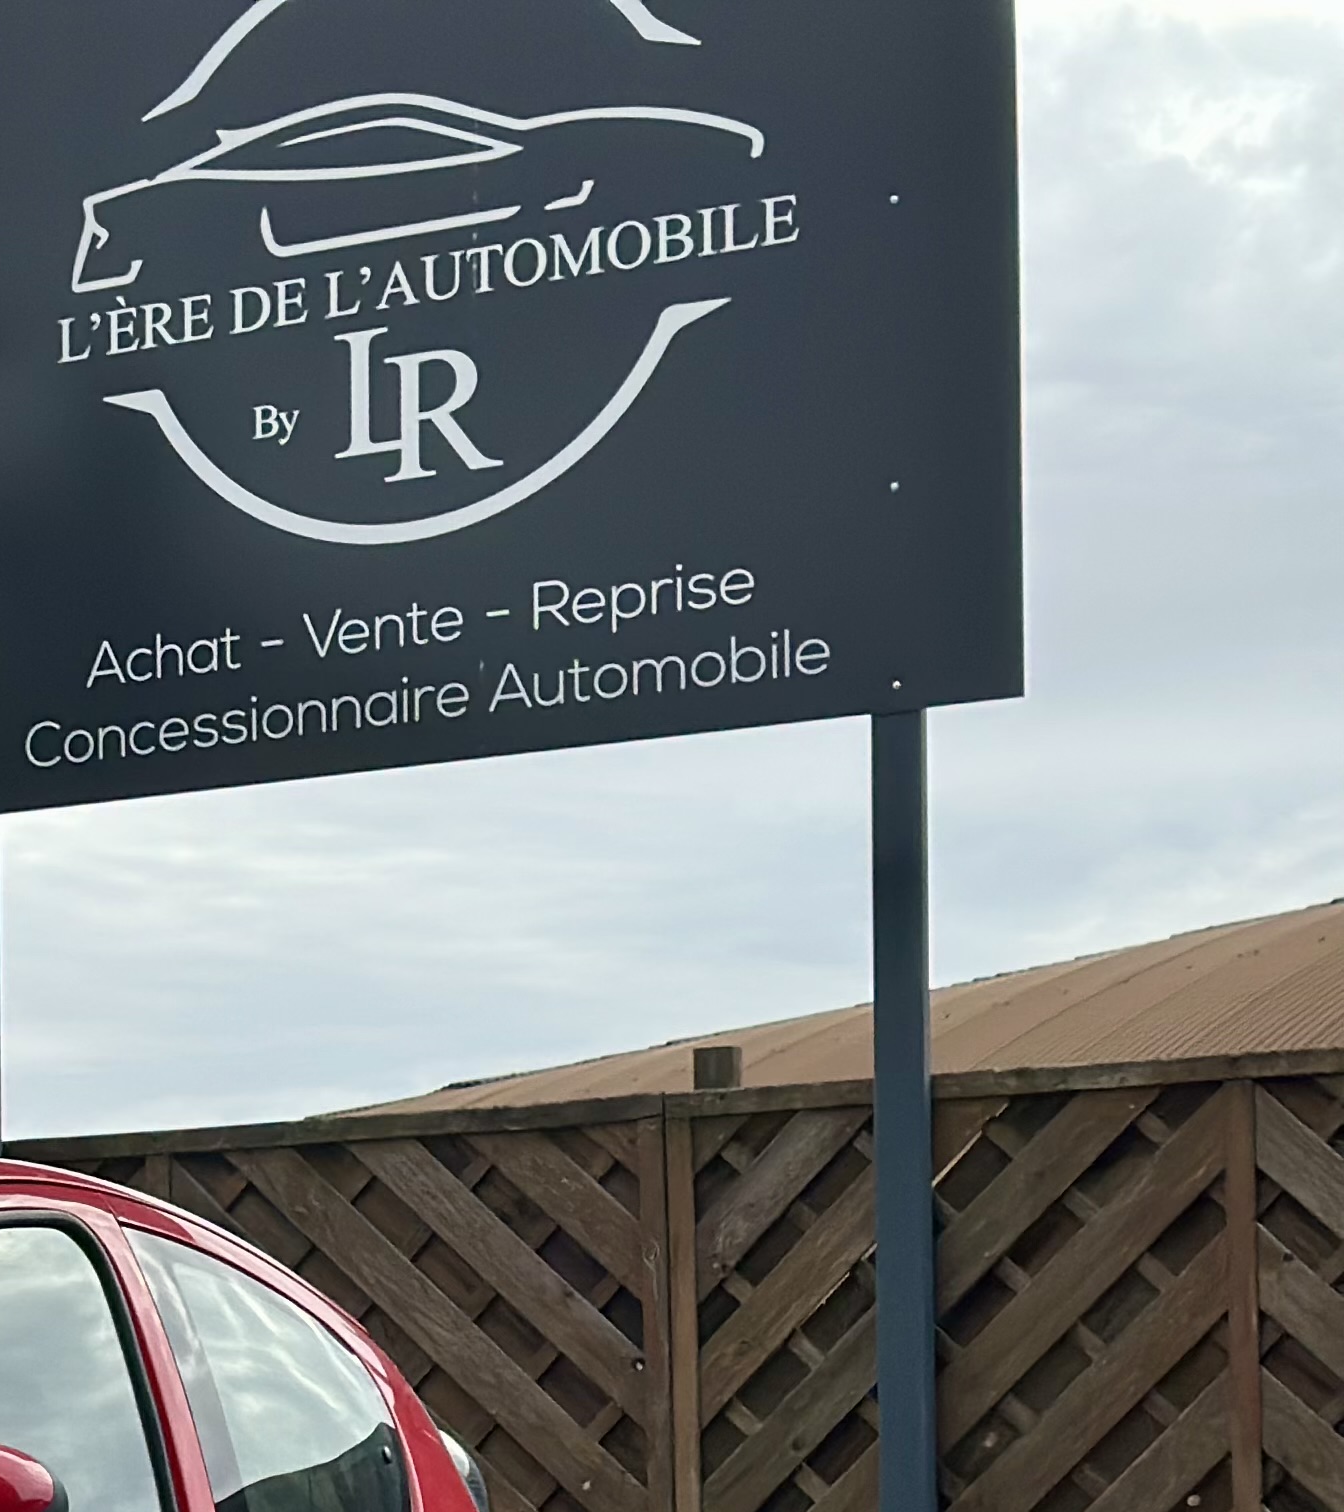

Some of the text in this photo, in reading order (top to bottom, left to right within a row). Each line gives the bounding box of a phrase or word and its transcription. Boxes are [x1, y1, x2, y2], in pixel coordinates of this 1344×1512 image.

[228, 277, 309, 335] DE
[323, 194, 800, 320] L'AUTOMOBILE
[252, 326, 505, 483] By LR
[86, 627, 242, 689] Achat
[302, 602, 464, 658] Vente
[532, 563, 755, 635] Reprise
[25, 628, 831, 768] Concessionnaire Automobile
